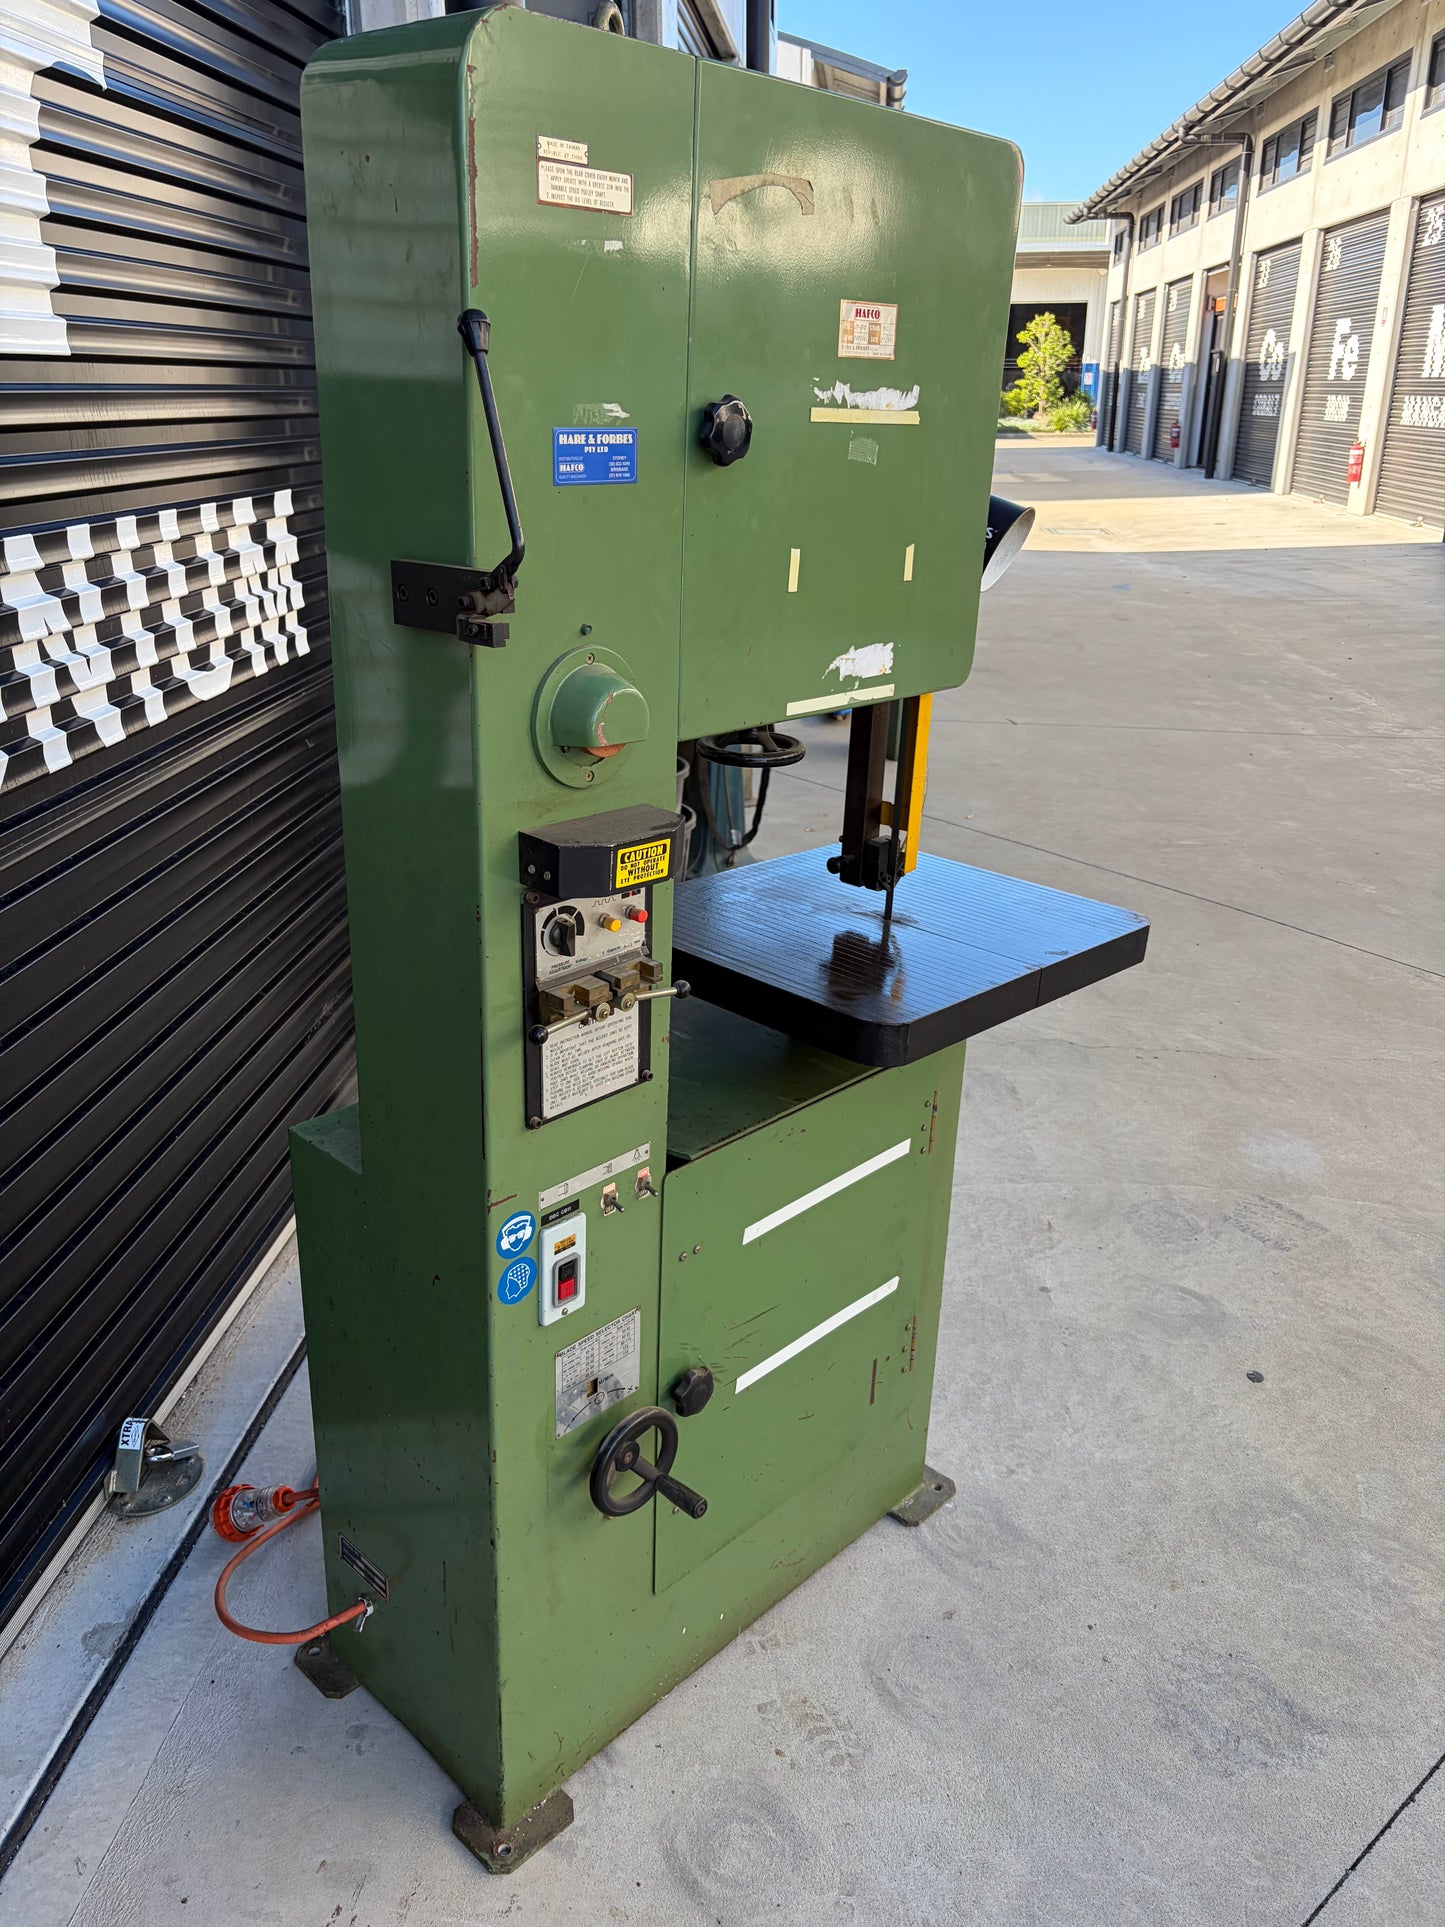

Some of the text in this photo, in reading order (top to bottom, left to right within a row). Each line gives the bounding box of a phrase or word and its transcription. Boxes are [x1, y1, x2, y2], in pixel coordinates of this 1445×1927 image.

[855, 308, 880, 320] HAFCO
[1327, 318, 1360, 380] Fe
[559, 434, 633, 445] HARE & FORBES
[560, 463, 584, 472] HAFCO
[0, 488, 311, 788] NIUM
[625, 845, 663, 862] CAUTION
[644, 856, 665, 865] OPERATE
[628, 863, 658, 876] WITHOUT
[634, 869, 663, 880] PROTECTION
[551, 959, 570, 969] PRESSURE
[560, 1310, 638, 1356] BLADE SPEED SELECTOR CHART
[120, 1420, 132, 1445] XTRA
